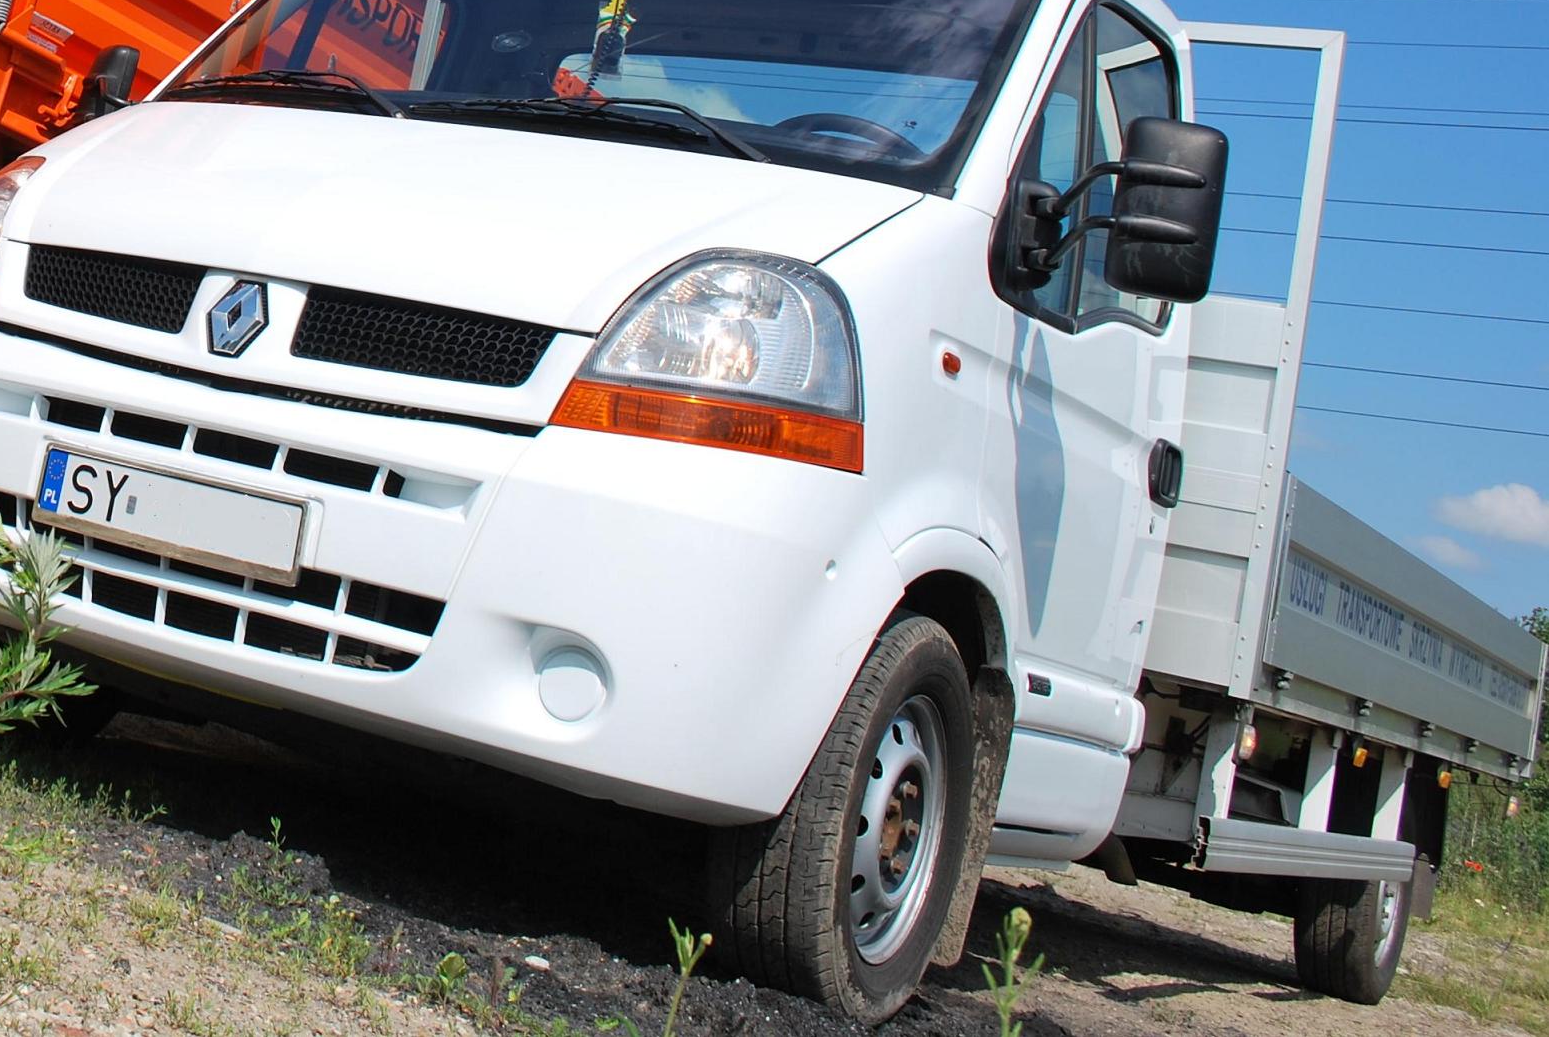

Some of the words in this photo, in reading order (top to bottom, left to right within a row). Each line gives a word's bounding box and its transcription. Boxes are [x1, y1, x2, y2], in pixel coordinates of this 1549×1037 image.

[43, 488, 57, 504] PL
[67, 464, 130, 522] SY
[1336, 581, 1404, 652] TRANSPORTOWE
